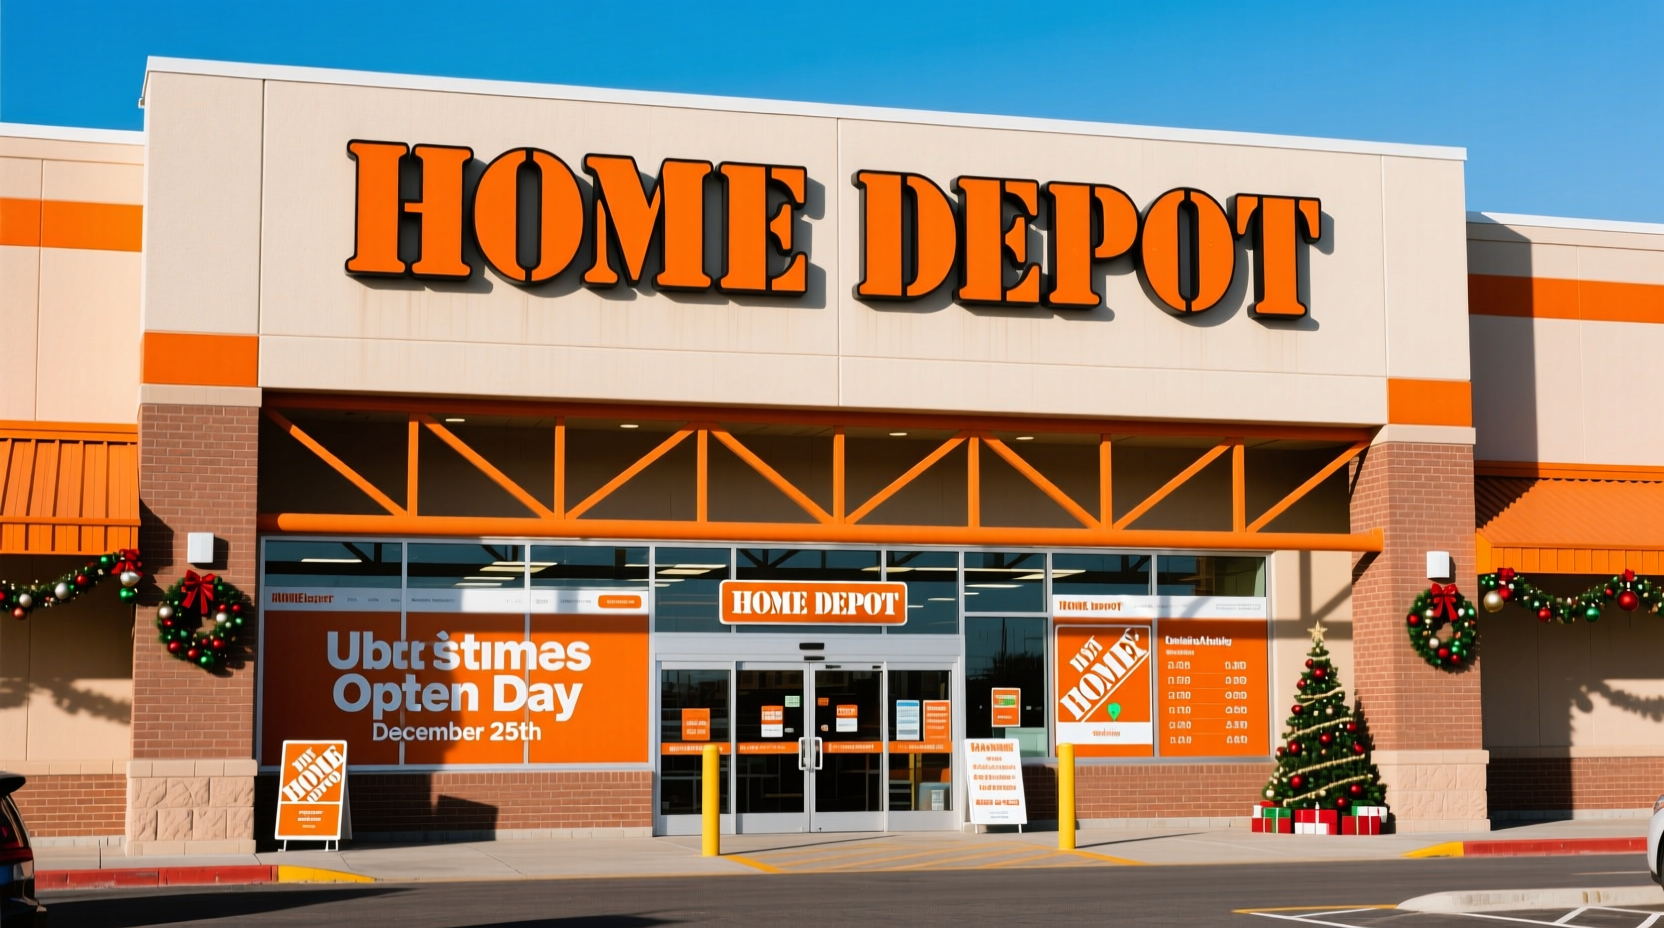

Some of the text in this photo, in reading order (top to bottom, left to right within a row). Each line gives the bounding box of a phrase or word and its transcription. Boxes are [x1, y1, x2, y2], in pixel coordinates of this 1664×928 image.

[344, 138, 1321, 320] HOME DEPOT
[732, 590, 899, 616] HOME DEPOT
[333, 673, 584, 722] Opten Day
[372, 721, 542, 741] December 25th
